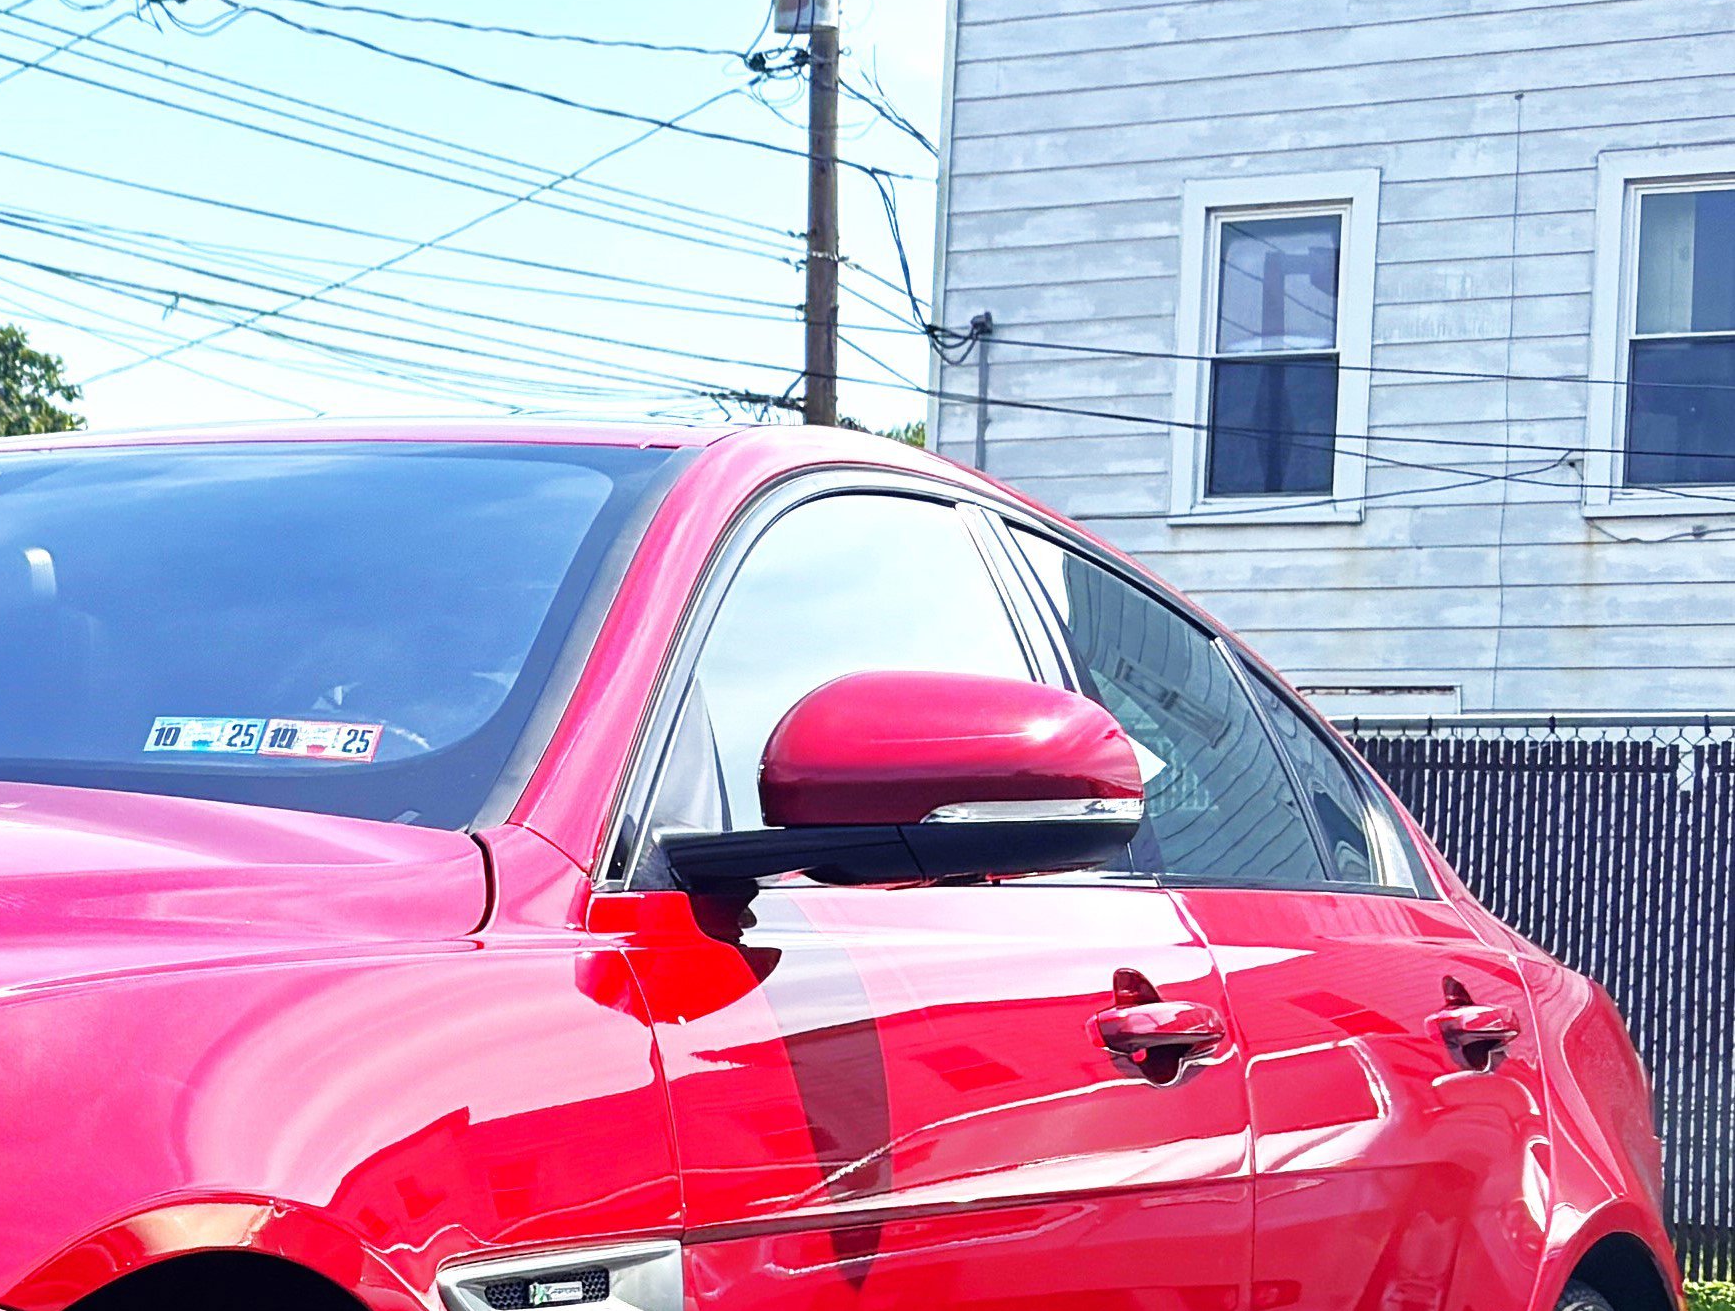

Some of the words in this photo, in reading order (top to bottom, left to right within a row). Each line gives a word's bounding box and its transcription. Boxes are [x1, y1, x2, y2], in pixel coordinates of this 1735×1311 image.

[154, 726, 181, 747] 10
[226, 723, 258, 748] 25
[268, 727, 298, 749] 10
[341, 729, 374, 753] 25
